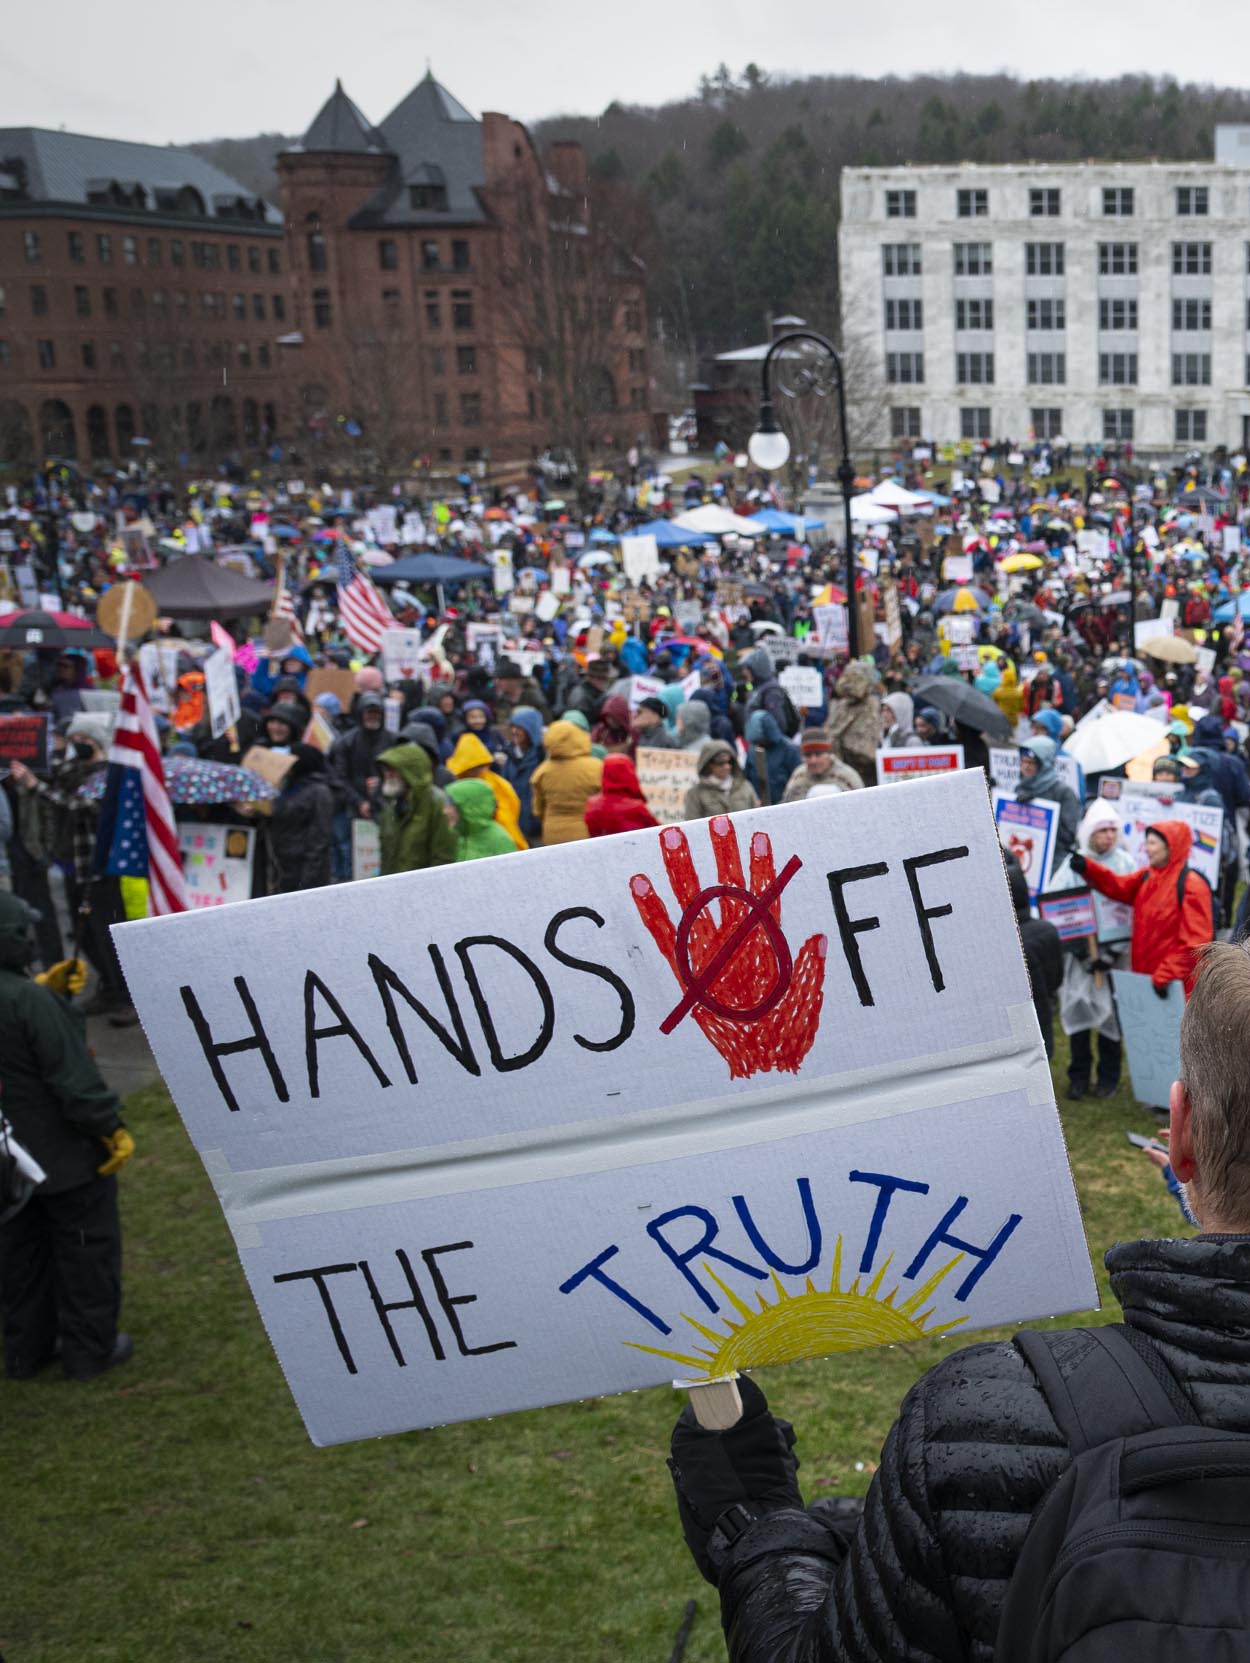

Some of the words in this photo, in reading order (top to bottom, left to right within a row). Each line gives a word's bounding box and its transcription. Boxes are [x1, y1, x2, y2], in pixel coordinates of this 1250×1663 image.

[180, 907, 635, 1112] HANDS
[274, 1241, 517, 1374] THE
[560, 1170, 1021, 1335] TRUTH
